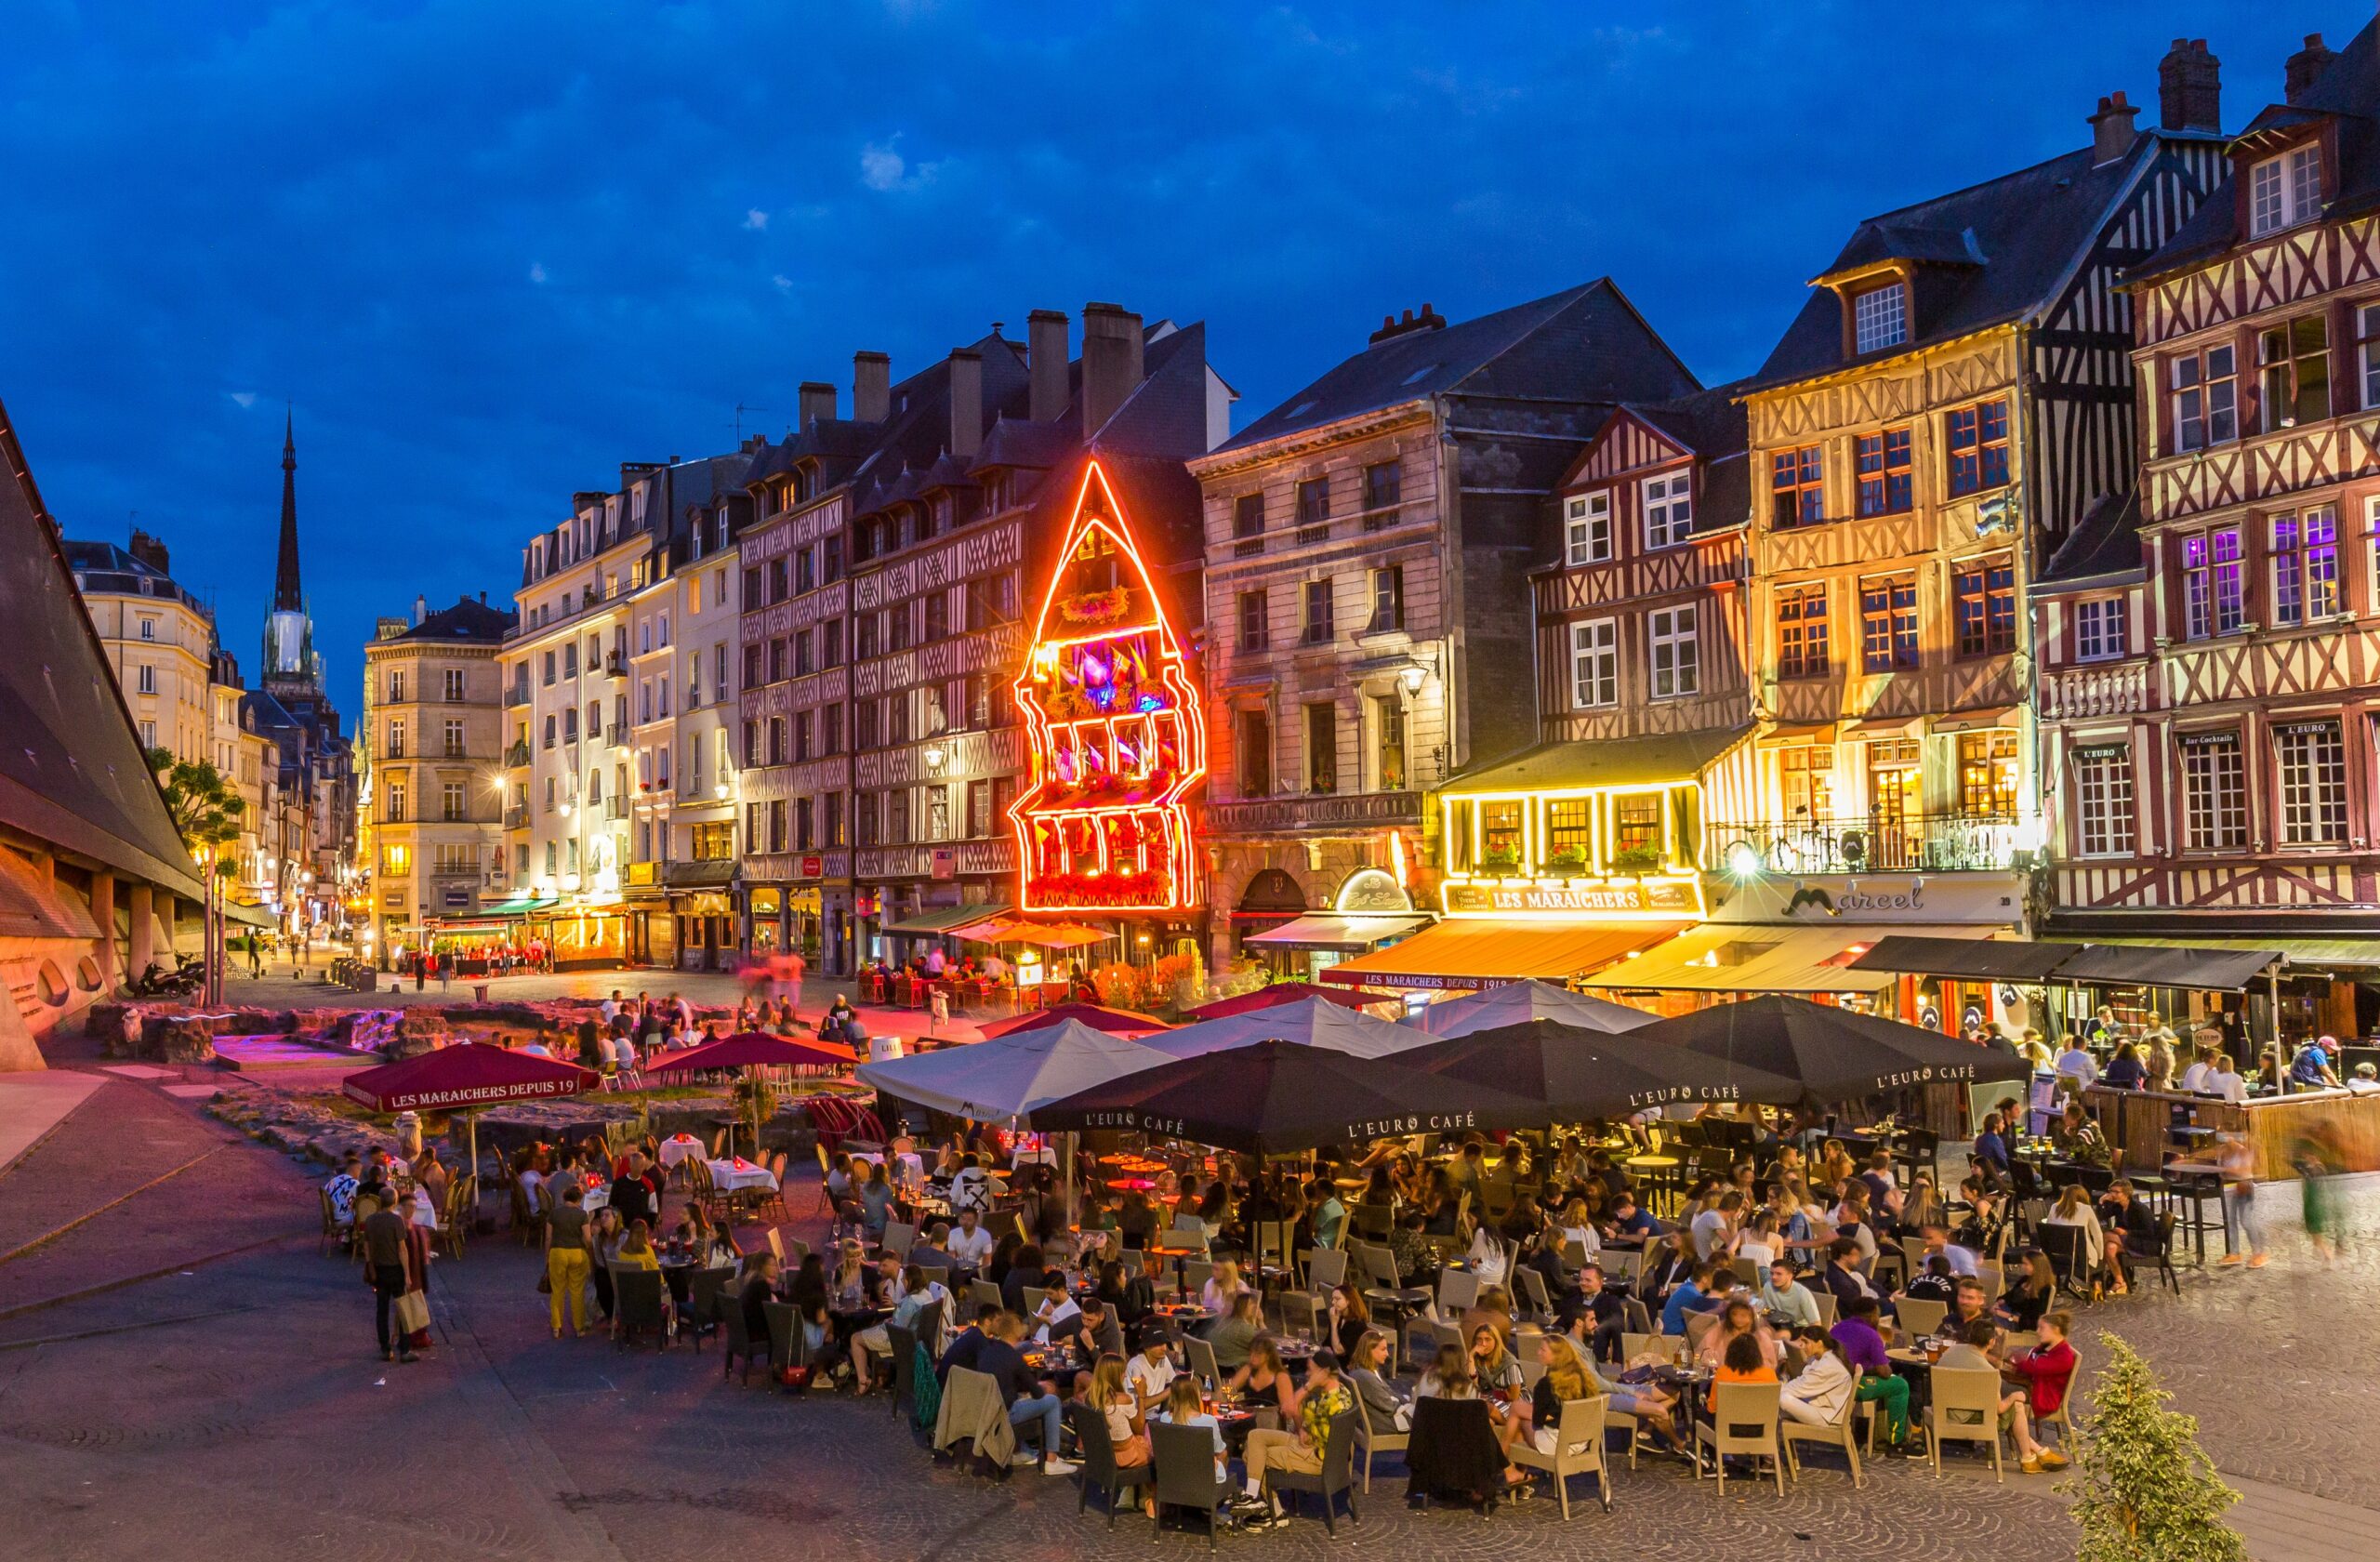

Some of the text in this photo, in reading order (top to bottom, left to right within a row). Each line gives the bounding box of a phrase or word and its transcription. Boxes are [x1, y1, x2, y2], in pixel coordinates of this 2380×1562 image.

[2288, 723, 2326, 735] L'EURO
[2083, 748, 2115, 758] L'EURO
[1493, 892, 1522, 908] LES
[1366, 974, 1382, 985] LES
[1385, 975, 1443, 987] MARAICHERS
[1447, 978, 1478, 988] DEPUIS
[1877, 1063, 1975, 1089] L'EURO CAFÉ
[391, 1079, 574, 1107] LES MARAICHERS DEPUIS 19
[1630, 1083, 1739, 1106] L'EURO CAFÉ
[1086, 1113, 1183, 1135] L'EURO CAFÉ
[1348, 1110, 1474, 1138] L'EURO CAFÉ
